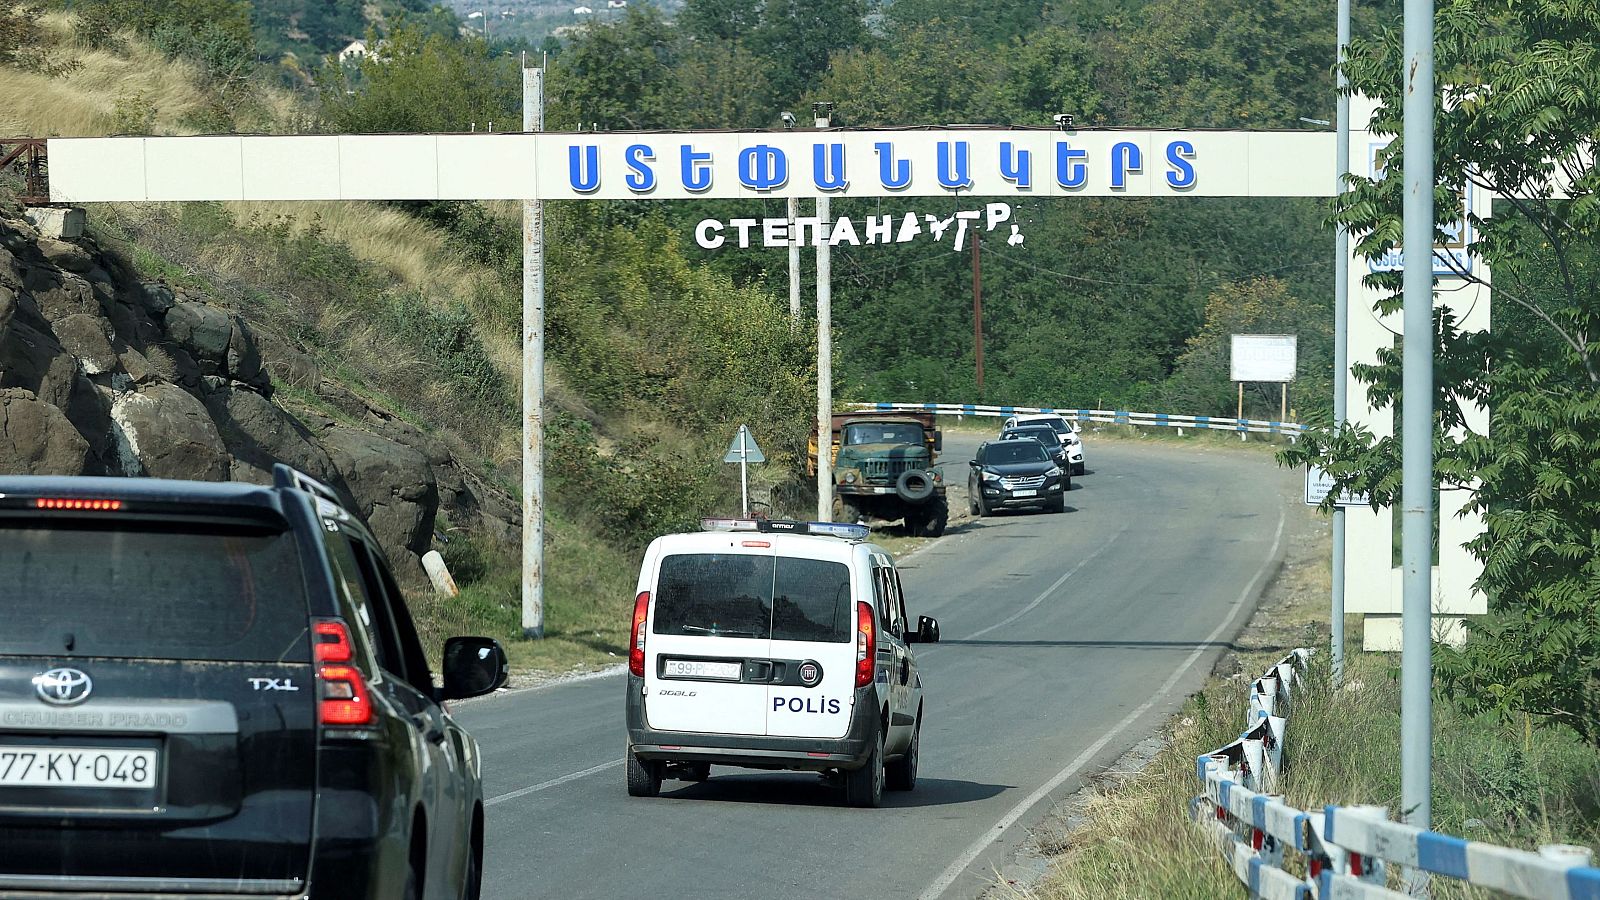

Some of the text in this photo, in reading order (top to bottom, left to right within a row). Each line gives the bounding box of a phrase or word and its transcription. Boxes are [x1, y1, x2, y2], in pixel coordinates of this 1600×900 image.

[568, 140, 1197, 194] ՍՏԵՓԱՆԱԿԵՐՏ
[2, 710, 188, 728] CRUISER PRADO
[0, 752, 148, 783] 77-KY-048
